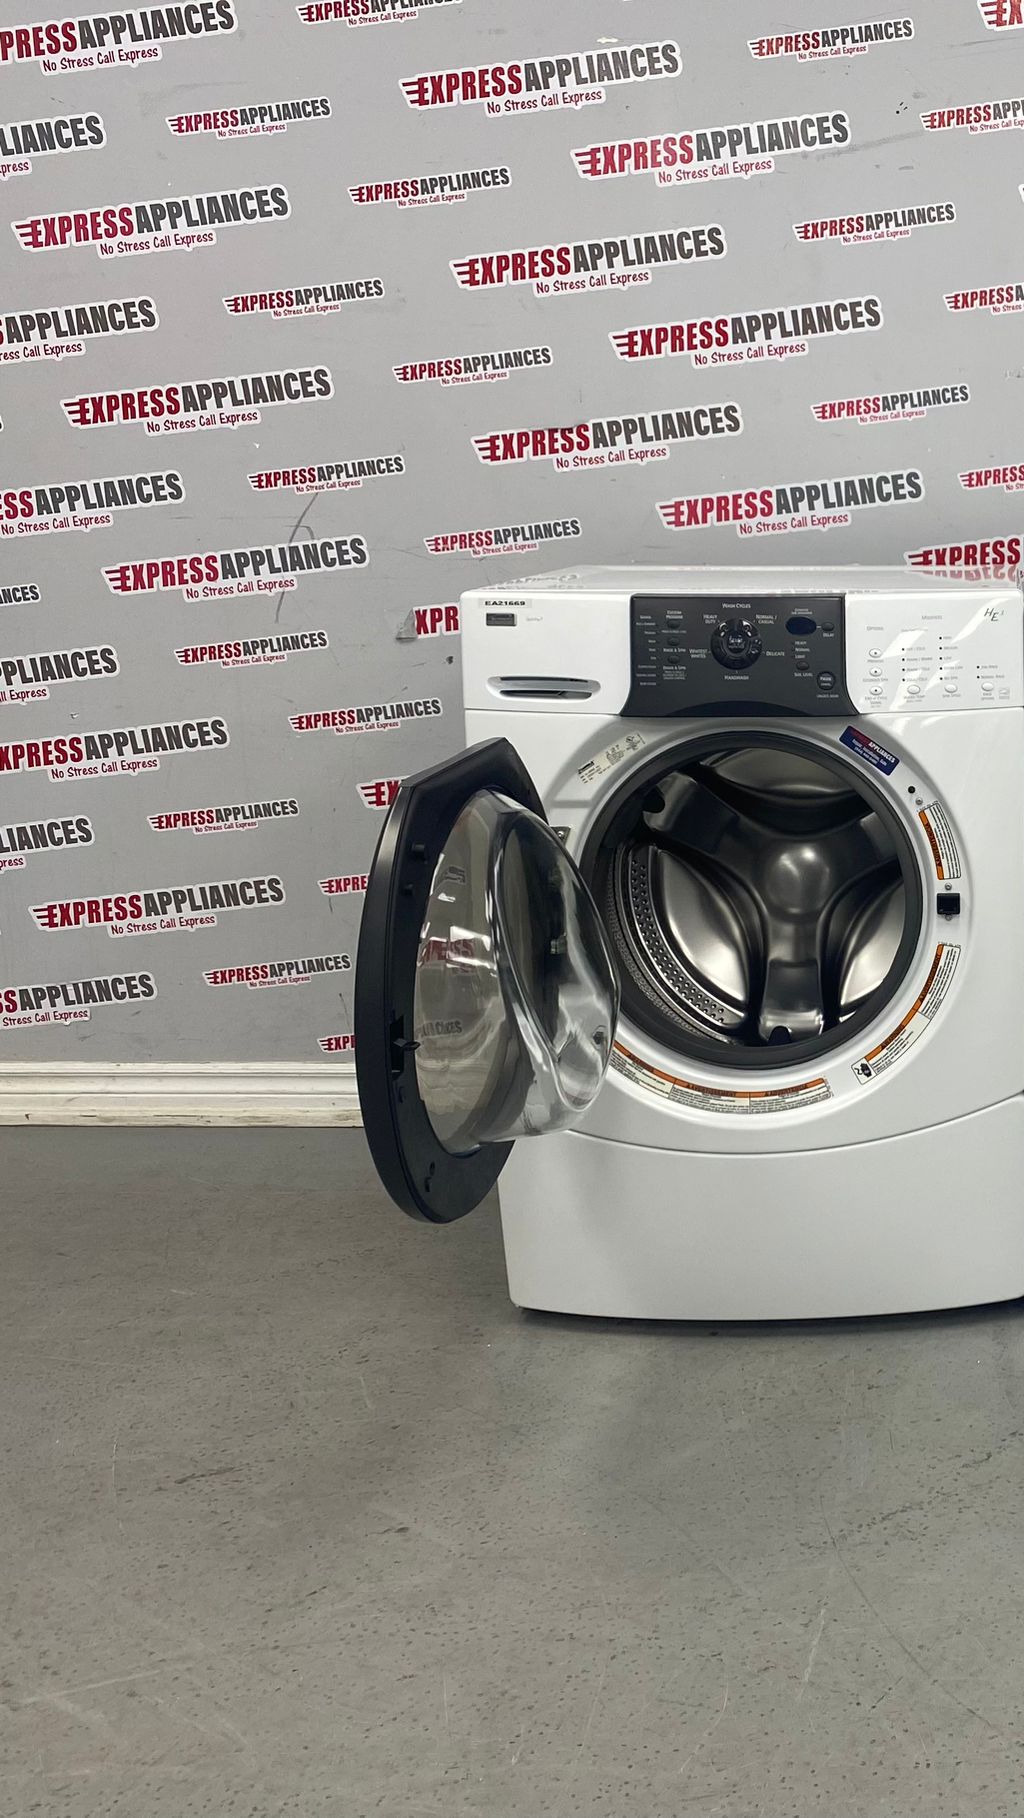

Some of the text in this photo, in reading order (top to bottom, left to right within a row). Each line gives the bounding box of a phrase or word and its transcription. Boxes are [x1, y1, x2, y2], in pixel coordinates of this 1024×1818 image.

[99, 232, 215, 257] No Stress Call Express
[0, 299, 156, 344] APPLIANCES
[0, 474, 182, 519] SSAPPLIANCES
[185, 578, 296, 600] No Stress Call Express
